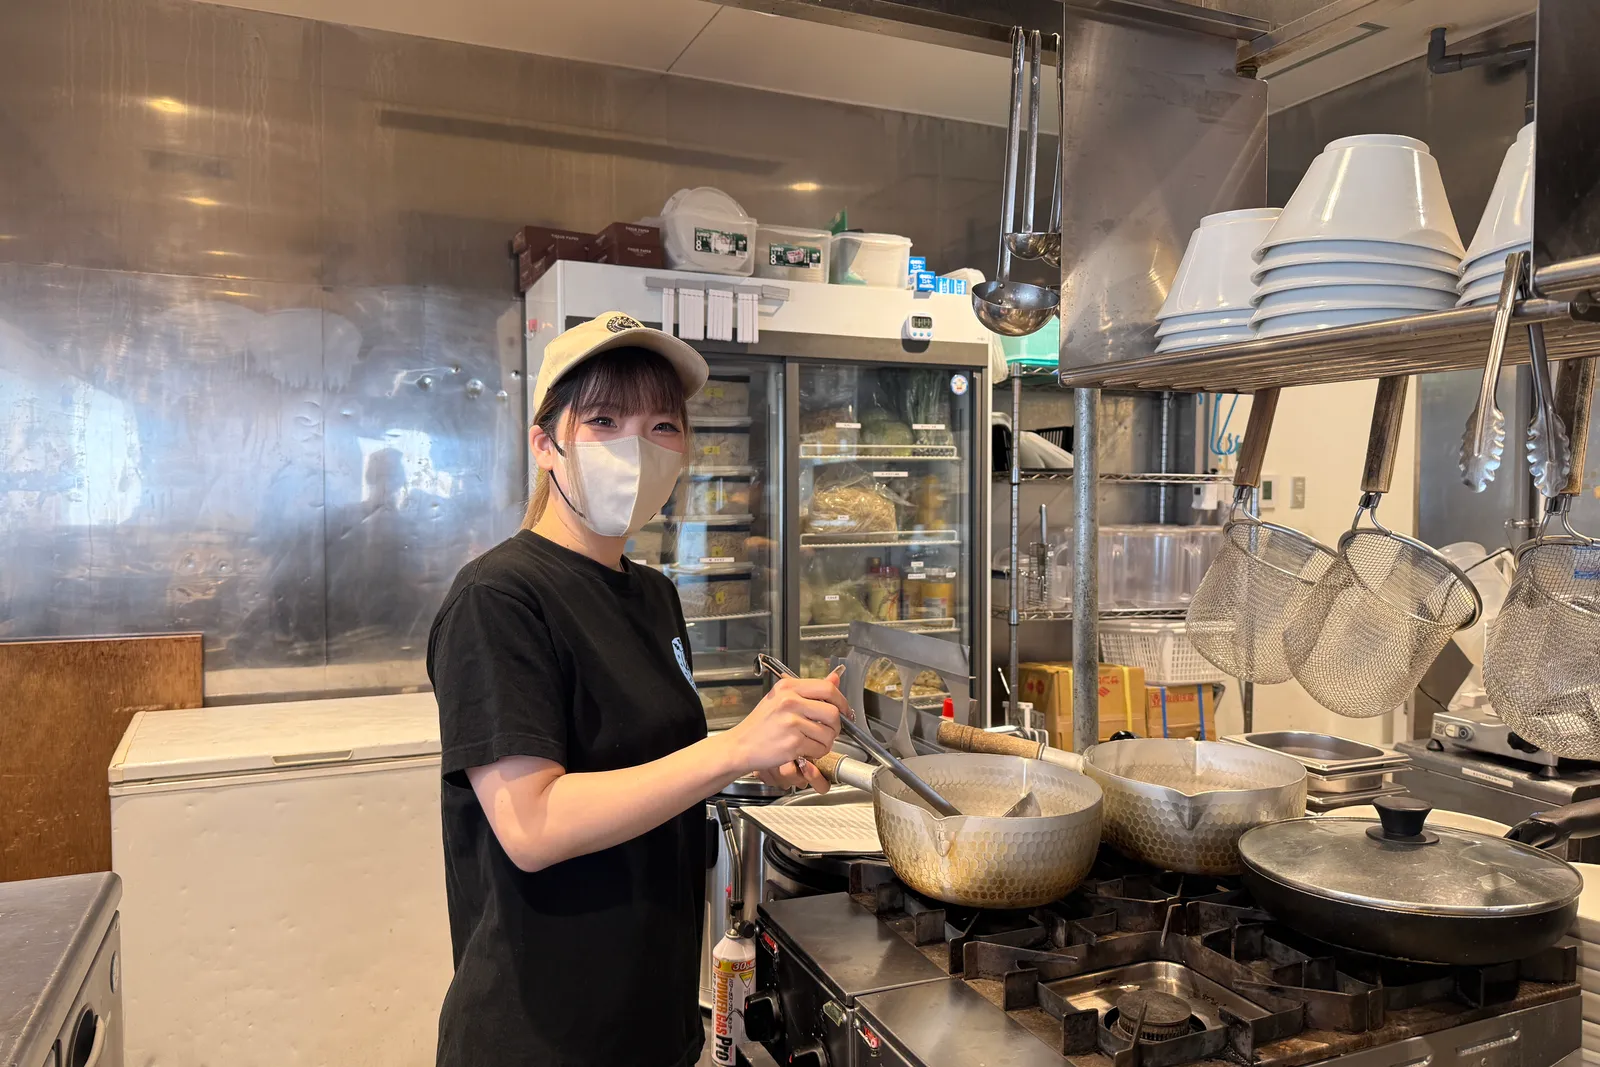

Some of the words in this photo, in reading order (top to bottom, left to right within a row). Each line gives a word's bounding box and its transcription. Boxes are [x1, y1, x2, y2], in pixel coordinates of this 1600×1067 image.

[695, 240, 702, 251] 8
[770, 254, 777, 265] 8
[716, 976, 728, 1014] POWER
[715, 1012, 728, 1036] GAS
[715, 1034, 733, 1061] Pro
